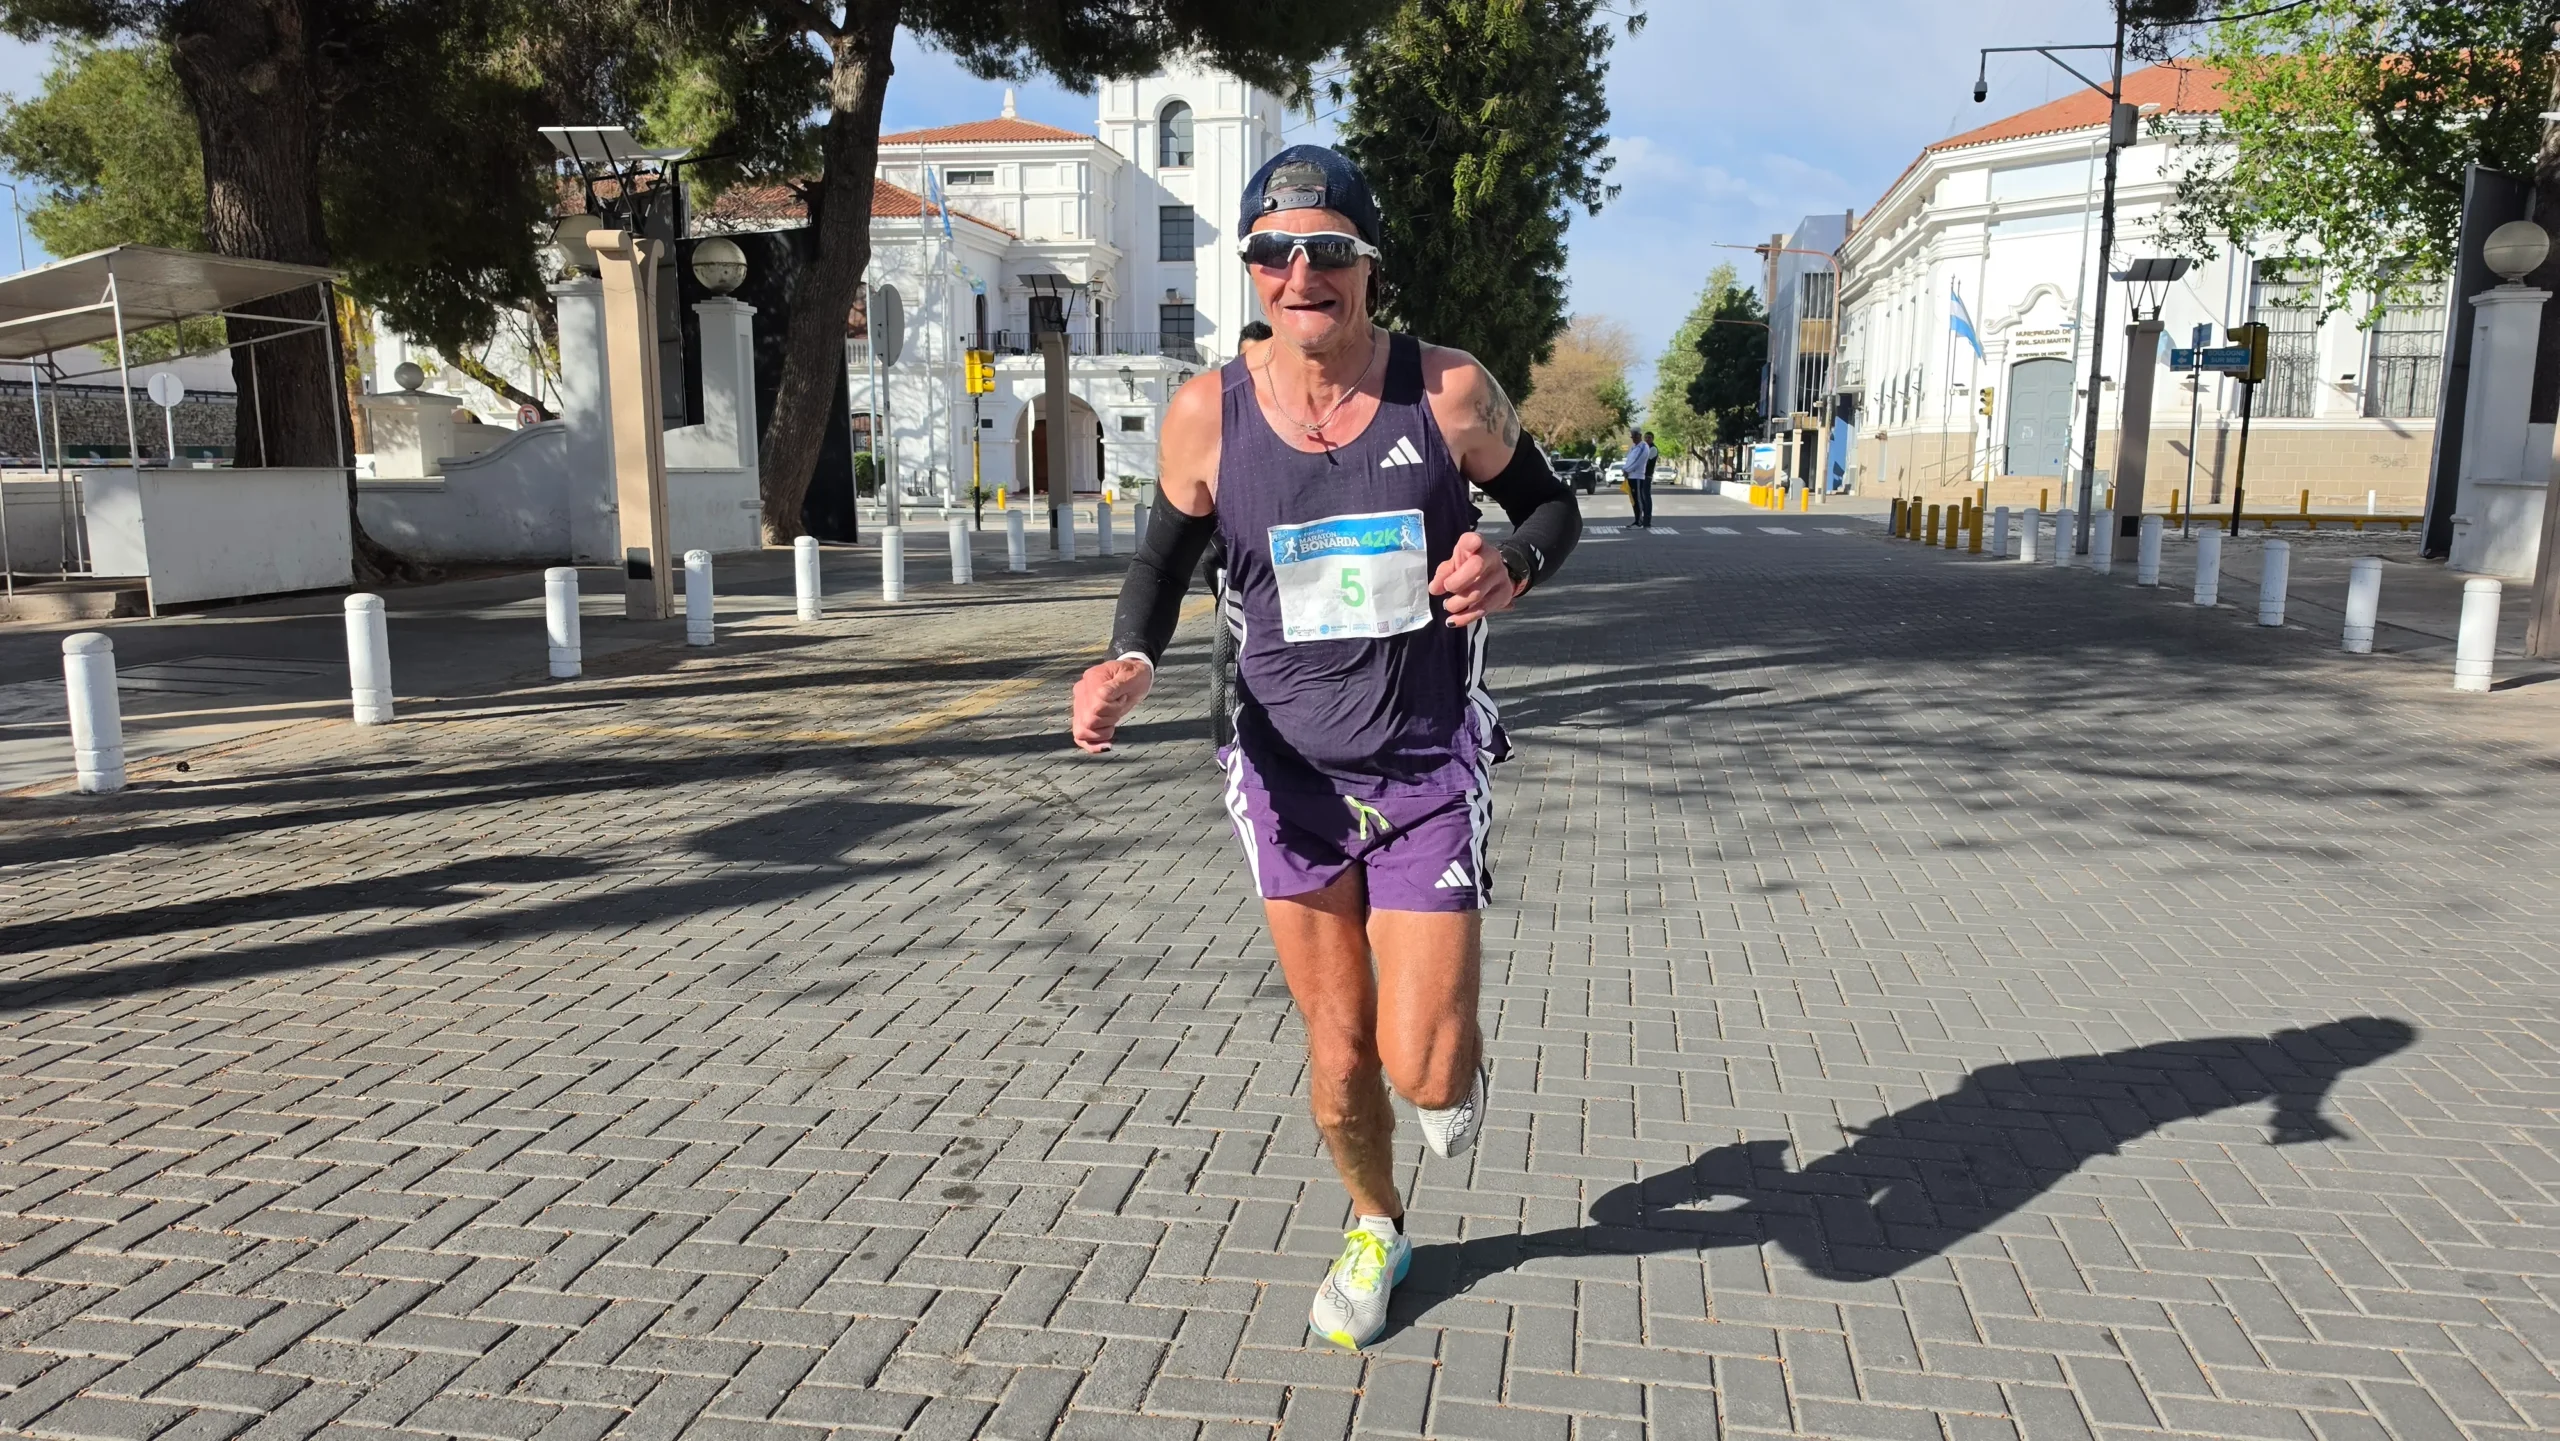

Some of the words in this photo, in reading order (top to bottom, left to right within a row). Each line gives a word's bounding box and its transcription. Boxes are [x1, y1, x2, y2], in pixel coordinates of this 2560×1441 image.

[1299, 530, 1337, 545] MARATÓN
[1300, 536, 1361, 554] BONARDA
[1360, 527, 1400, 548] 42K
[1341, 567, 1366, 608] 5
